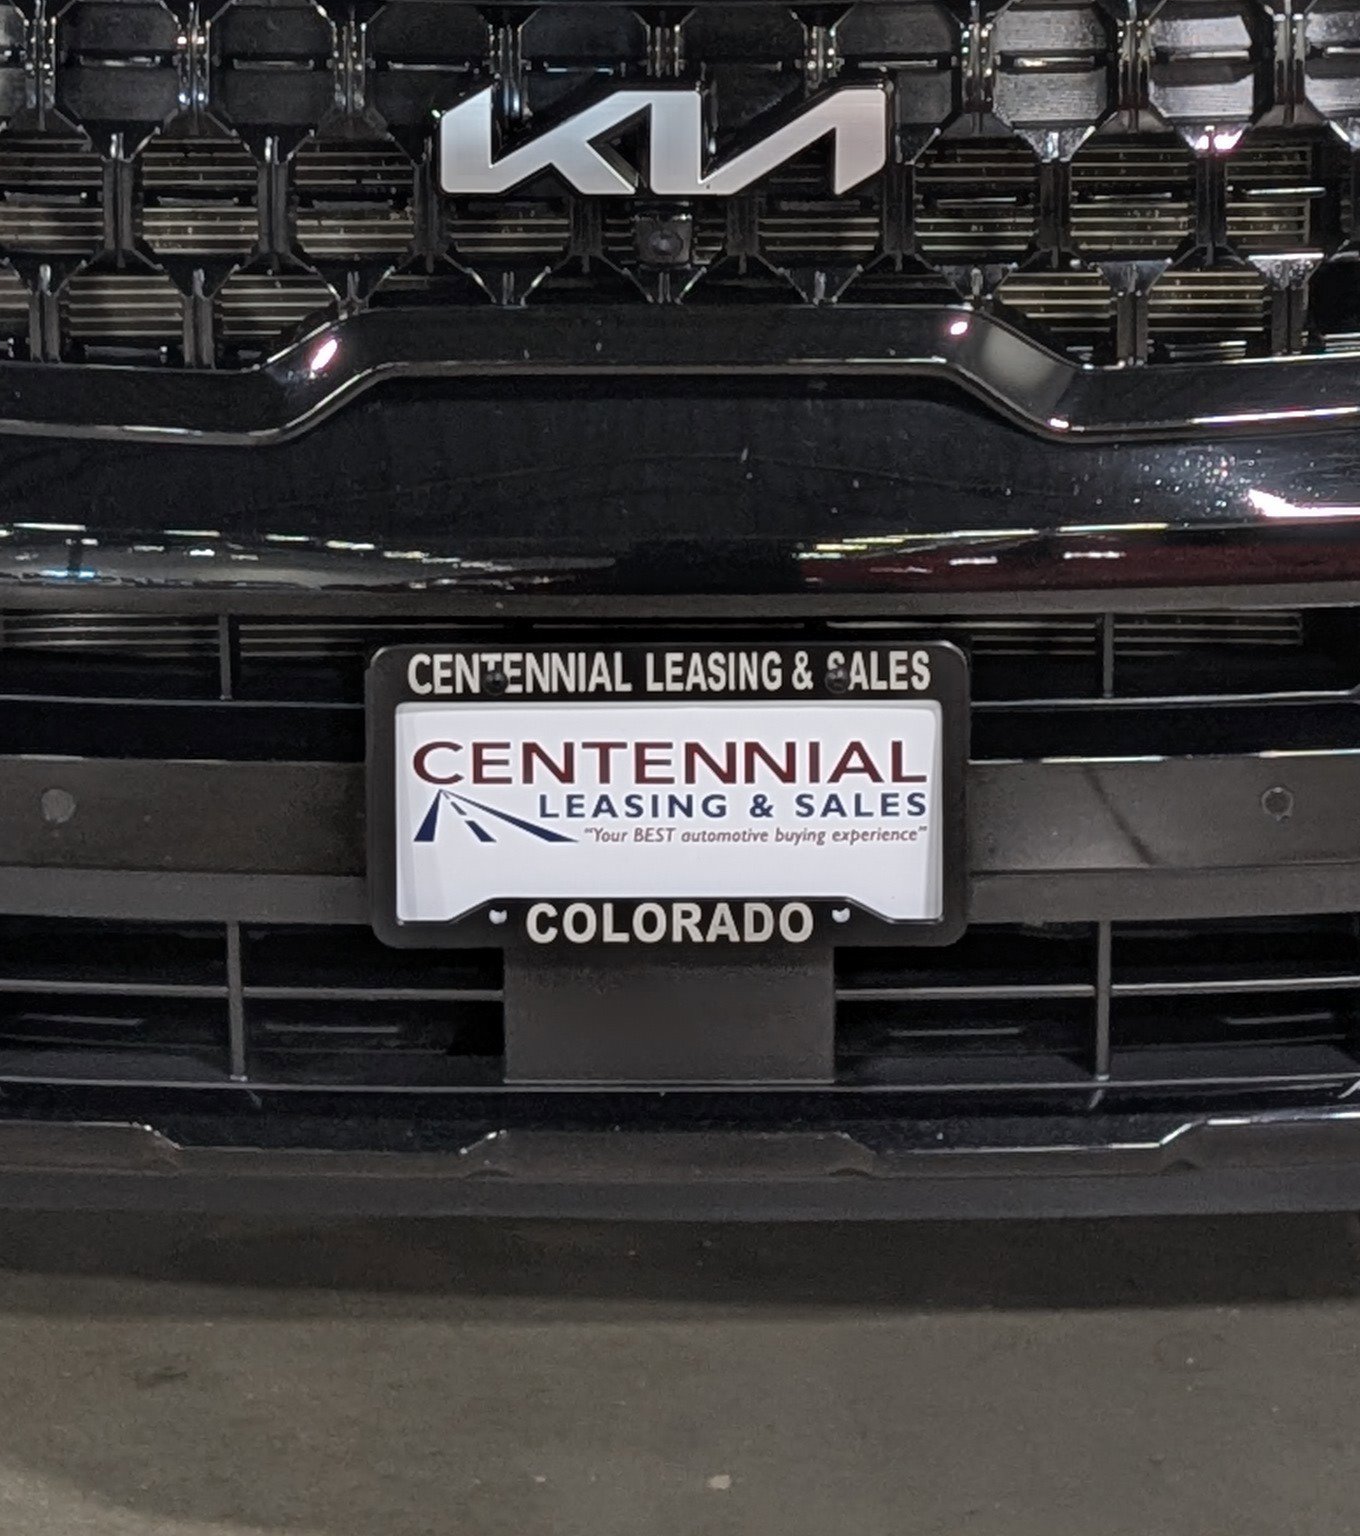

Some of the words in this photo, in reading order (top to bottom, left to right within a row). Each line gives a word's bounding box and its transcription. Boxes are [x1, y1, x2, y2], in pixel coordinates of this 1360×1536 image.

[645, 651, 782, 692] LEASING
[791, 650, 814, 690] &
[413, 740, 927, 785] CENTENNIAL
[539, 794, 727, 818] LEASING
[749, 794, 773, 817] &
[795, 792, 926, 817] SALES
[633, 827, 676, 843] BEST
[681, 828, 768, 843] automotive
[775, 826, 826, 846] buying
[526, 902, 814, 943] COLORADO
